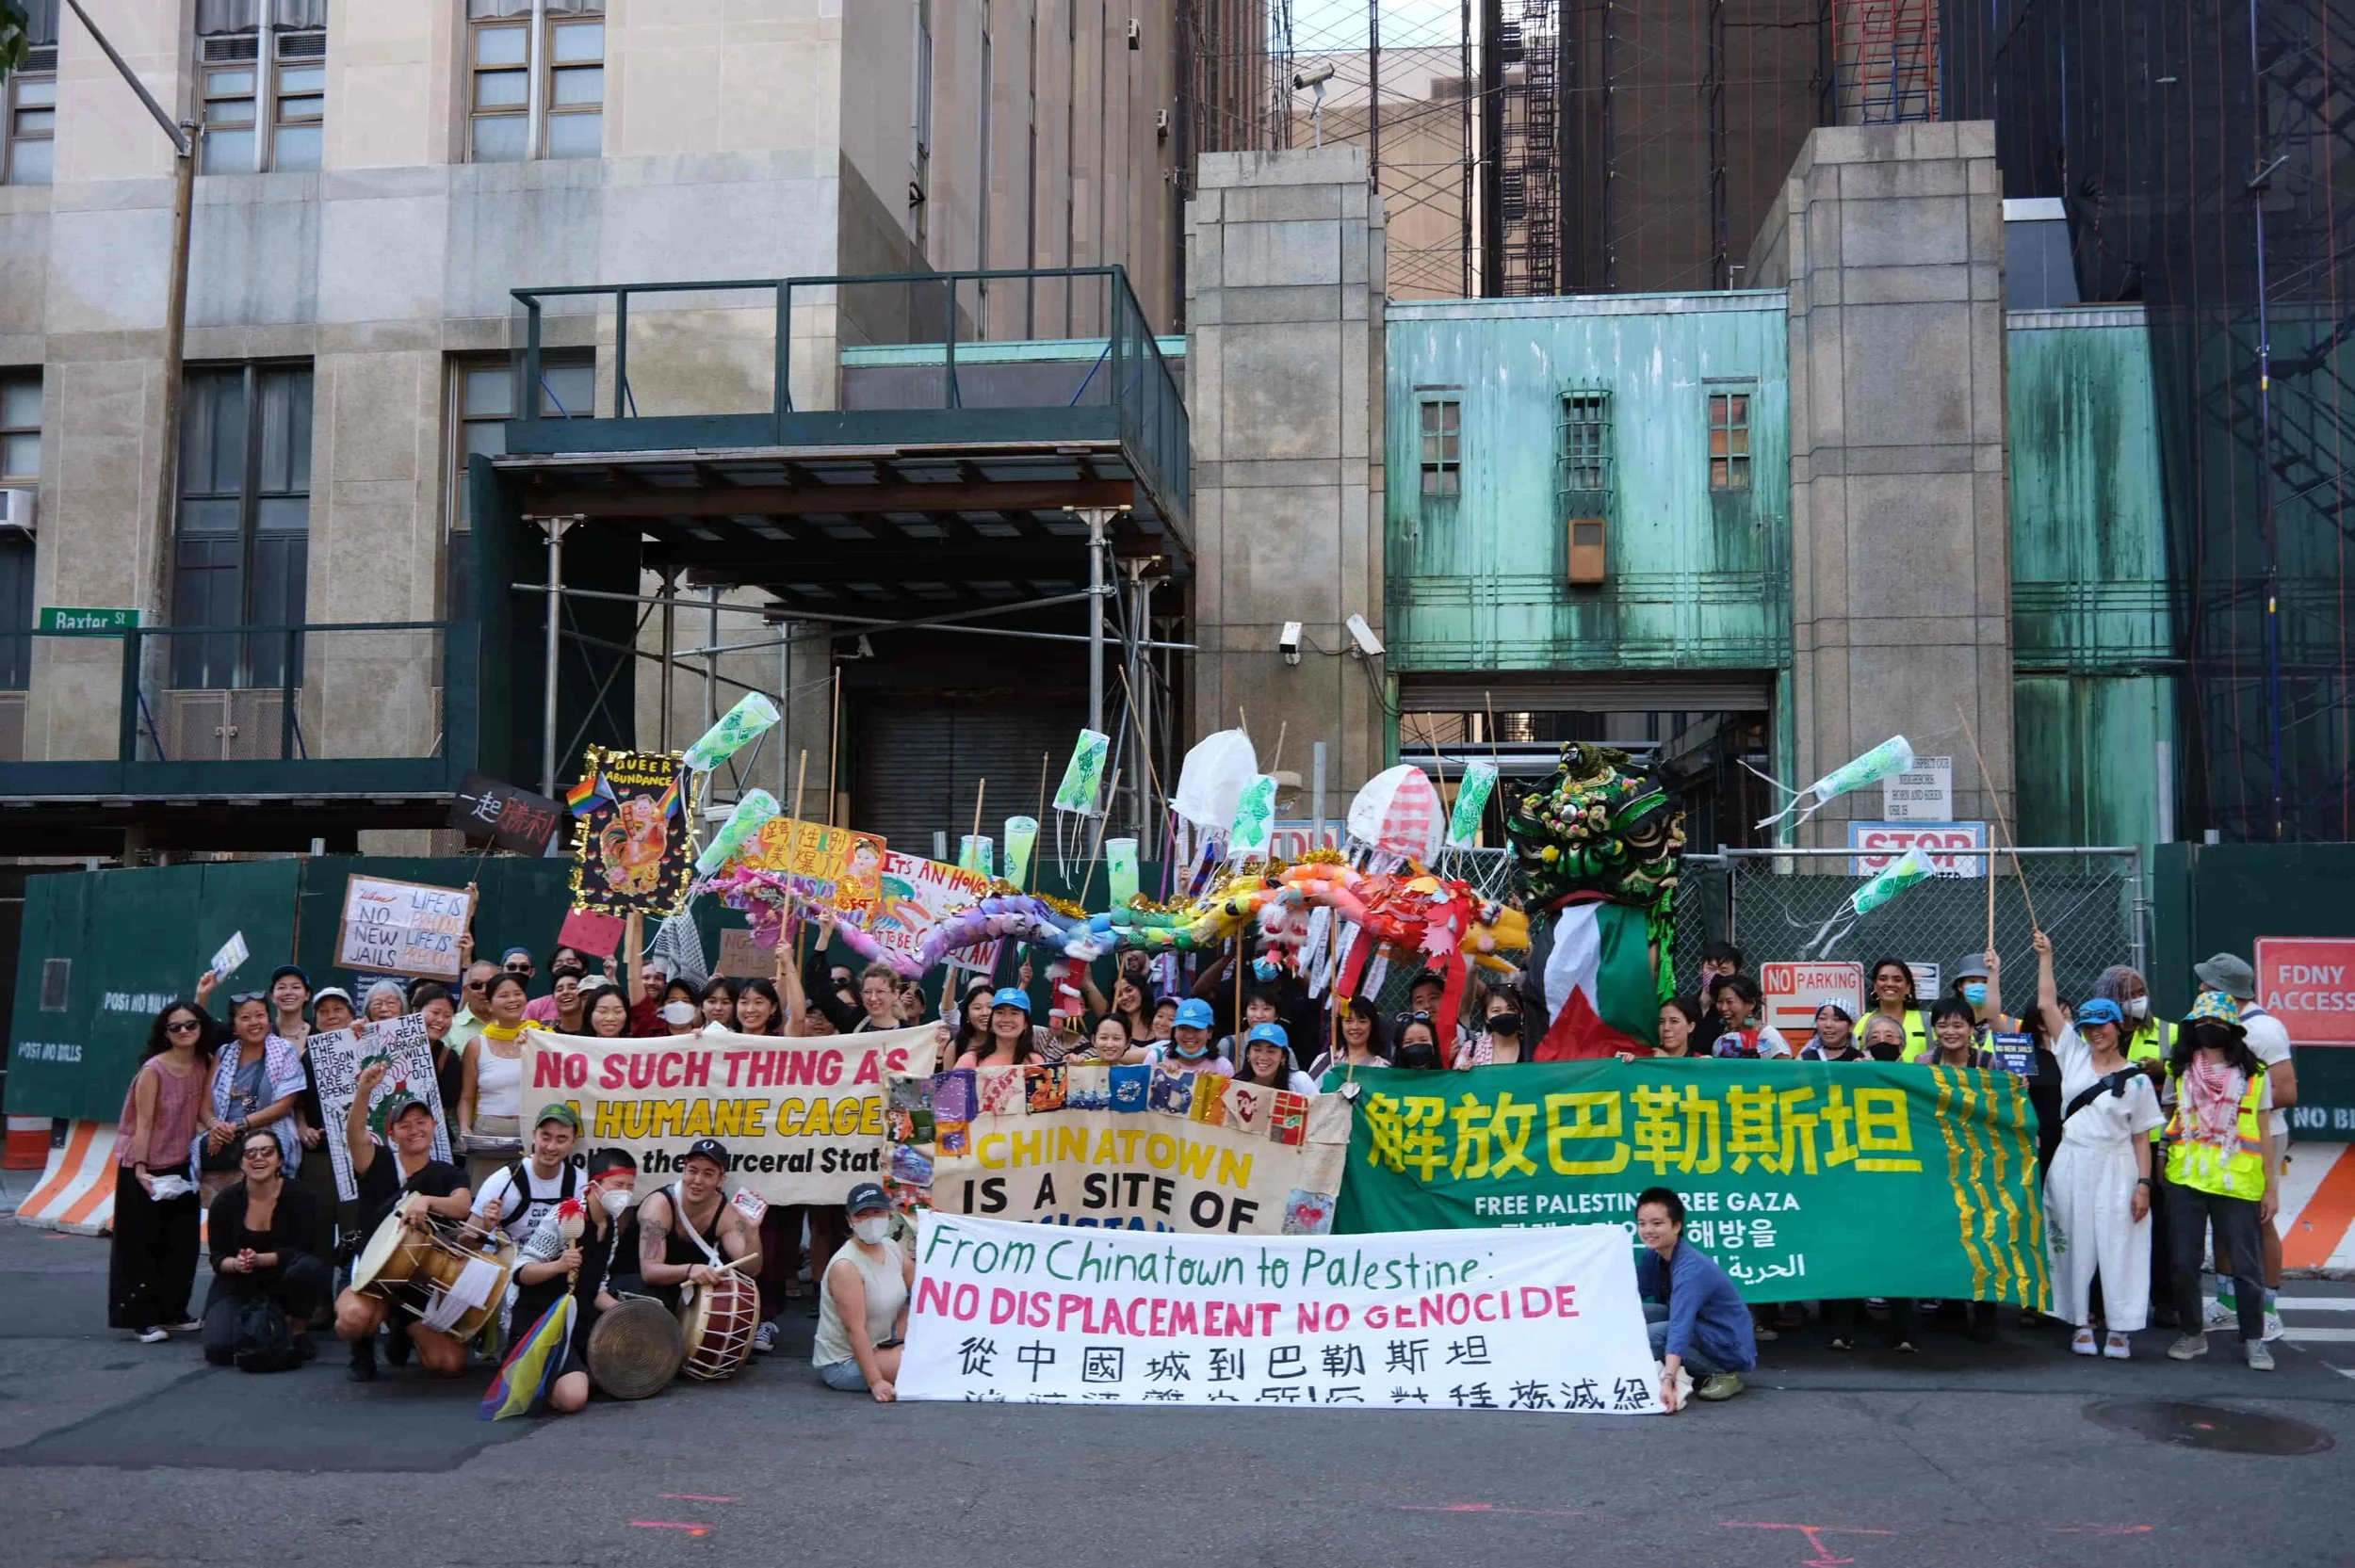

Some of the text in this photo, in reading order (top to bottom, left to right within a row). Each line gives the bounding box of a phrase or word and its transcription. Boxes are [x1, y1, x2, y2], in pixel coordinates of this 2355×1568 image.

[56, 611, 125, 629] Baxter St
[615, 759, 671, 773] QUEER
[606, 770, 674, 787] ABUNDANCE
[1864, 832, 1972, 867] STOP
[918, 861, 947, 885] AN
[412, 891, 463, 916] LIFE IS
[360, 906, 390, 925] NO
[354, 926, 398, 946] NEW
[405, 930, 452, 952] LIFE IS
[897, 932, 911, 949] BE
[349, 946, 397, 967] JAILS
[1767, 969, 1857, 992] NO PARKING
[2278, 965, 2346, 985] FDNY
[105, 992, 129, 1010] POST
[2266, 992, 2355, 1011] ACCESS
[398, 1014, 423, 1027] THE
[309, 1031, 342, 1047] WHEN
[396, 1026, 426, 1041] REAL
[19, 1042, 82, 1062] POST NO BILLS
[310, 1043, 334, 1057] THE
[388, 1037, 428, 1053] DRAGON
[403, 1046, 430, 1059] WILL
[313, 1050, 354, 1067] PRISON
[412, 1057, 431, 1070] FLY
[316, 1062, 353, 1081] DOORS
[412, 1066, 433, 1080] OUT
[534, 1049, 910, 1090] NO SUCH THING AS
[318, 1075, 342, 1091] ARE
[593, 1098, 770, 1140] HUMANE
[2293, 1107, 2327, 1128] NO
[1366, 1084, 1923, 1182] 解放巴勒斯坦
[642, 1147, 880, 1174] the rceral Stat
[976, 1125, 1254, 1189] CHINATOWN
[963, 1177, 1008, 1214] IS
[1033, 1172, 1056, 1210] A
[1082, 1172, 1176, 1215] SITE
[1190, 1189, 1259, 1234] OF
[1475, 1192, 1801, 1216] FREE PALESTIN REE GAZA
[1686, 1219, 1778, 1249] 해방을
[924, 1224, 1493, 1291] From Chinatown to Palestine:
[1728, 1253, 1806, 1285] الحرية
[916, 1276, 1580, 1337] NO DISPLACEMENT NO GENOCIDE
